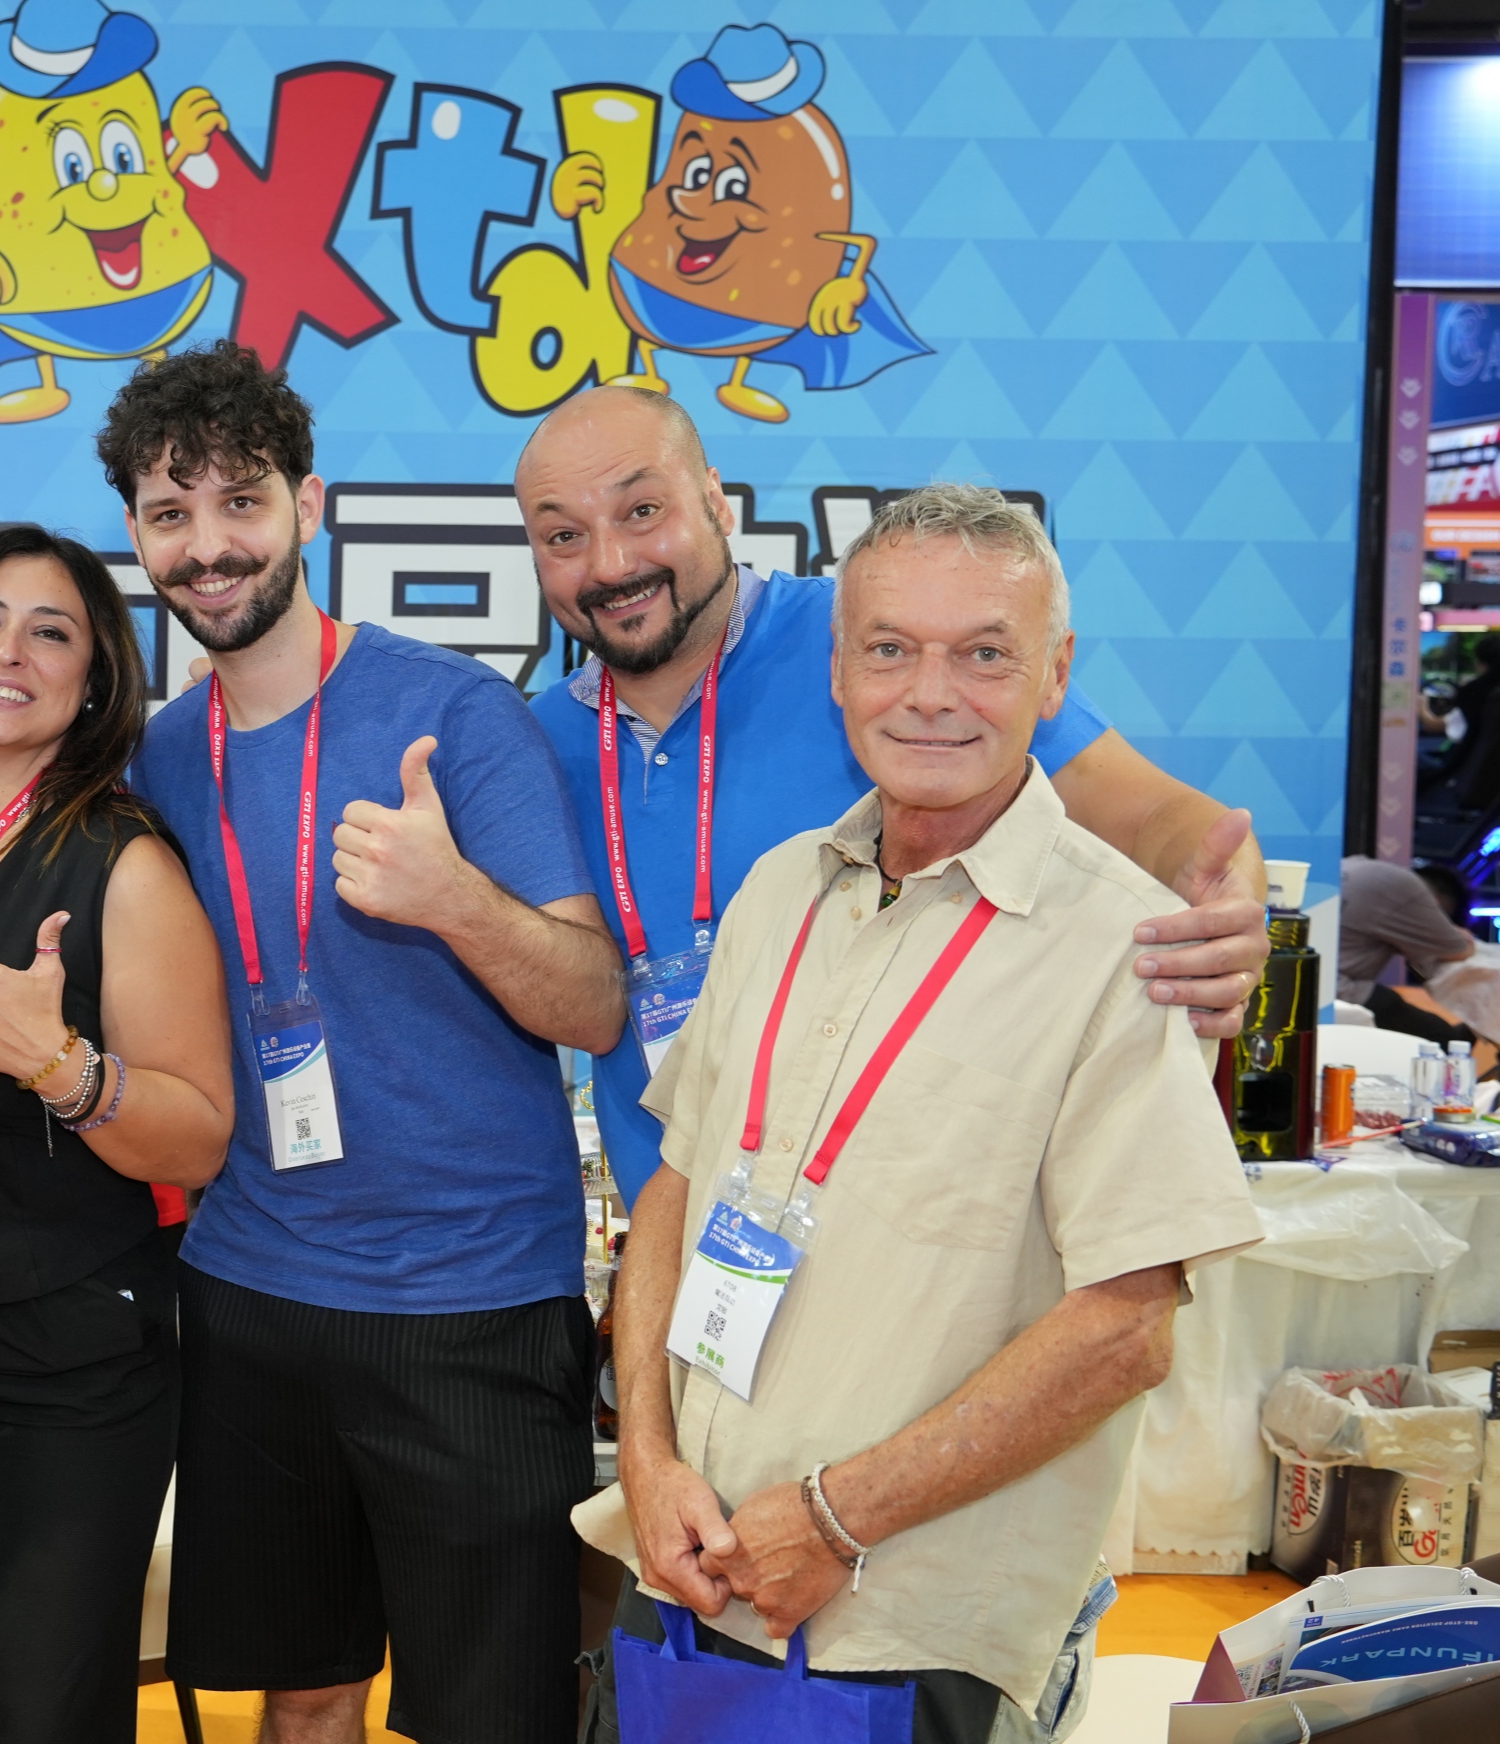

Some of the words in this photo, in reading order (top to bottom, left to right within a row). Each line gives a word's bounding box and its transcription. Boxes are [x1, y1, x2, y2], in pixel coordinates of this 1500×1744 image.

[603, 705, 612, 729] EXPO
[214, 733, 222, 756] EXPO
[603, 729, 612, 752] GTI
[703, 734, 711, 758] GTI
[702, 759, 711, 783] EXPO
[304, 791, 313, 813] GTI
[302, 813, 311, 839] EXPO
[300, 843, 309, 926] www.gti-amuse.com
[614, 866, 625, 890] EXPO
[619, 891, 632, 913] GTI
[642, 1019, 657, 1027] 17th
[656, 1015, 668, 1023] GTI
[667, 1009, 688, 1020] CHINA
[288, 1153, 311, 1163] Overseas
[311, 1150, 326, 1160] Buyer
[290, 1138, 322, 1154] 海外买家
[695, 1355, 721, 1376] Exhibitor
[696, 1341, 725, 1369] 参展商
[1411, 1621, 1443, 1629] SOLUTION
